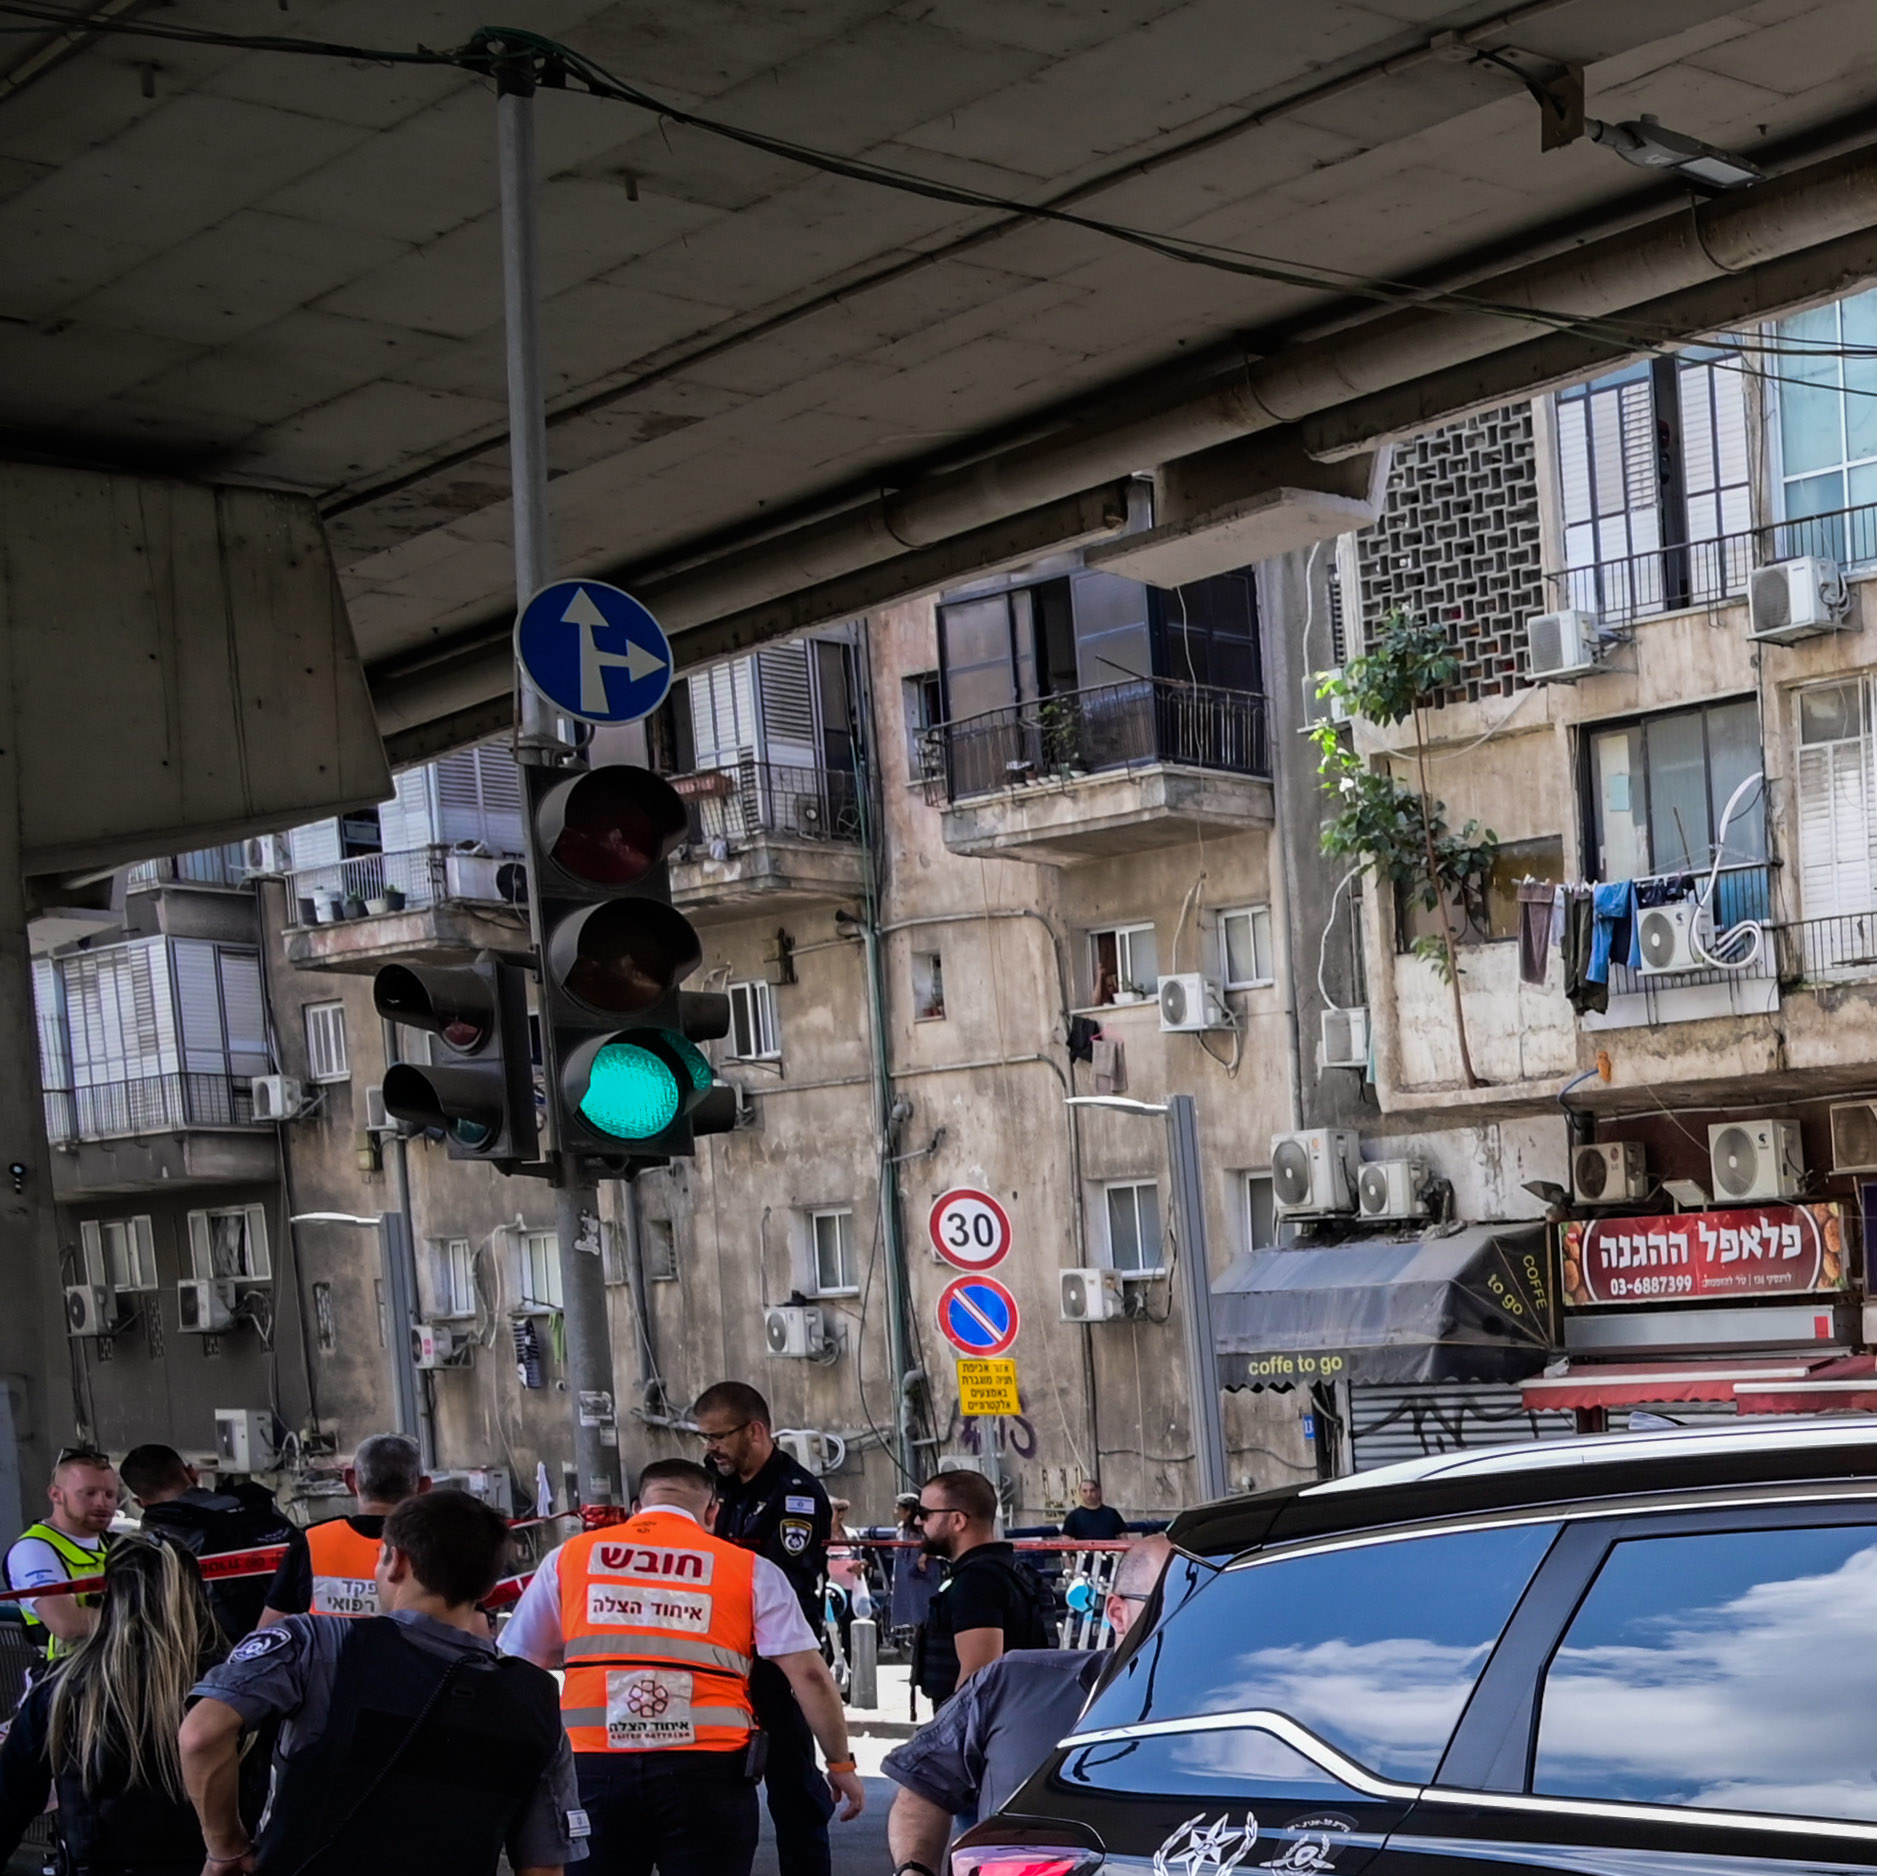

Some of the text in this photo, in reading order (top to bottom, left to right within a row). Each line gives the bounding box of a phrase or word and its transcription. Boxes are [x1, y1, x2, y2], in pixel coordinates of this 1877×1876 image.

[947, 1213, 994, 1247] 30
[1600, 1218, 1801, 1268] פלאפל ההגנה
[1487, 1273, 1524, 1316] to go
[1523, 1255, 1547, 1310] COFFE
[1610, 1275, 1692, 1296] 03-6887399
[1249, 1354, 1343, 1376] coffe to go
[600, 1547, 703, 1578] חובש
[327, 1596, 375, 1613] רפואי
[593, 1596, 703, 1621] איחוד הצלה
[609, 1720, 689, 1732] איחוד הצלה
